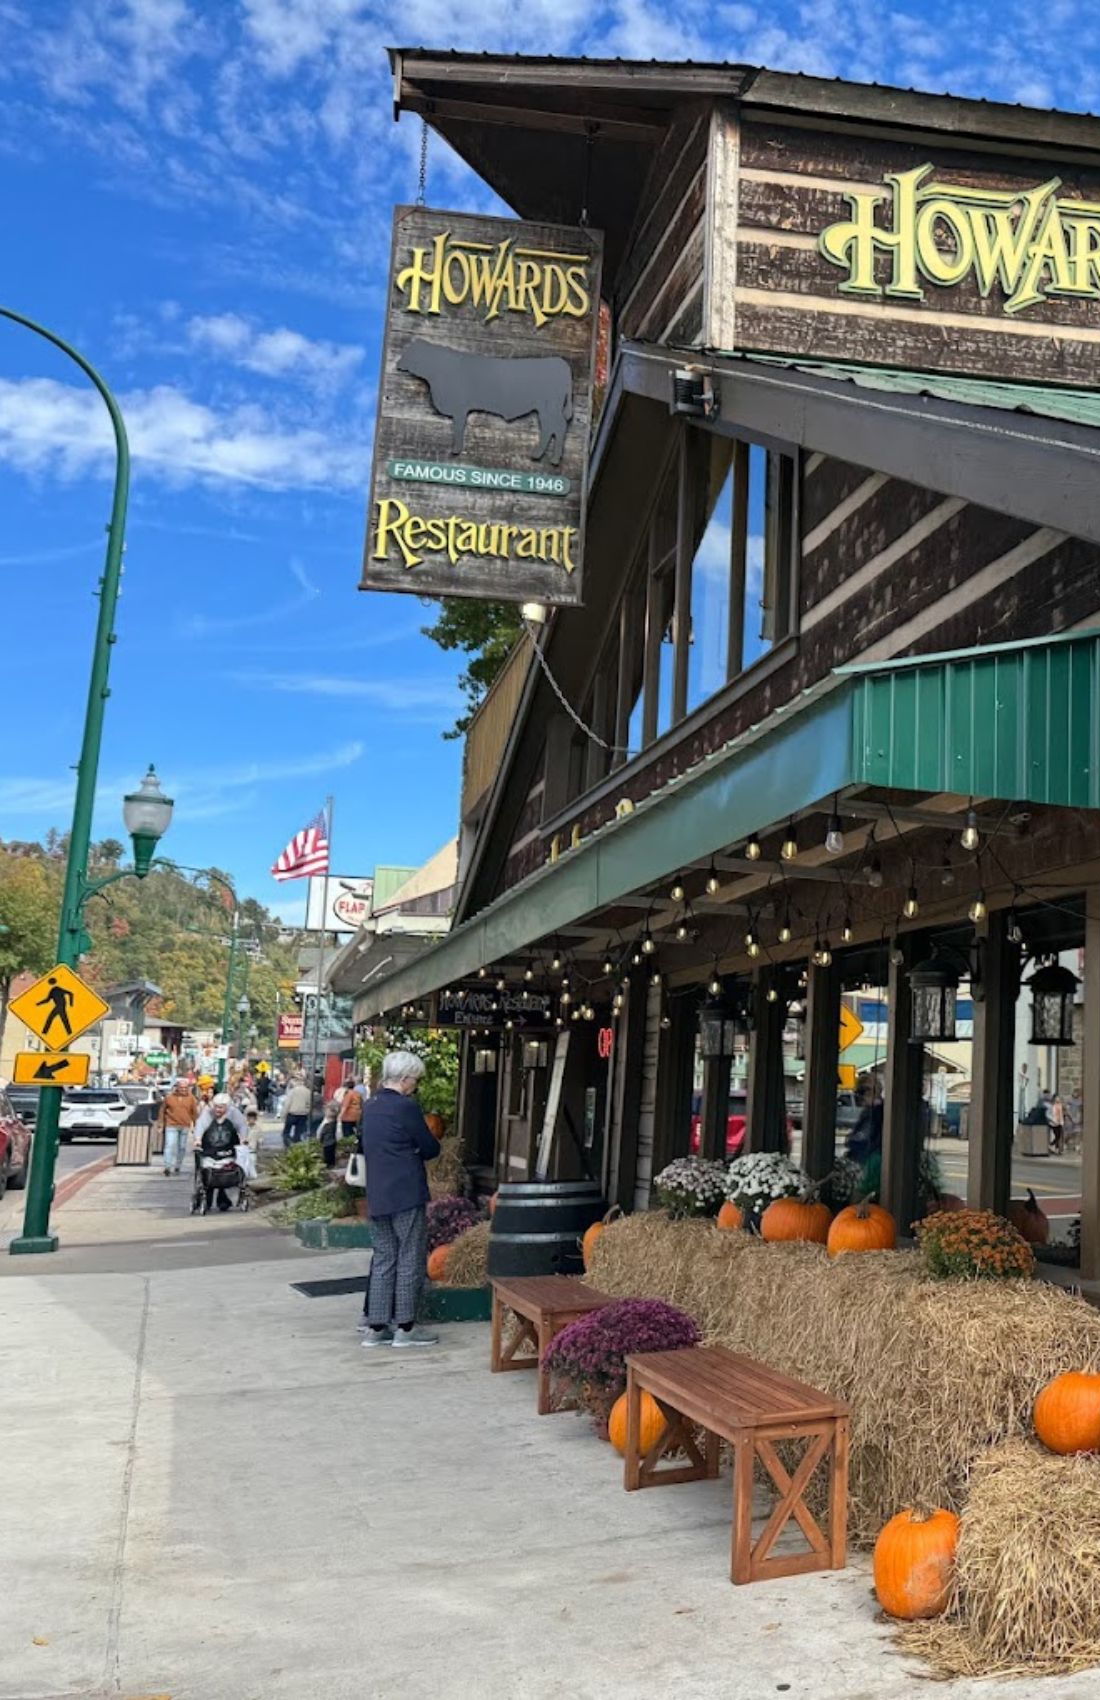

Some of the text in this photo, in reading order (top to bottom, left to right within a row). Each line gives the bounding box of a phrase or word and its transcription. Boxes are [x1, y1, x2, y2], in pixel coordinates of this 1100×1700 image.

[396, 230, 590, 327] HOWARDS
[394, 462, 565, 492] FAMOUS SINCE 1946
[371, 499, 578, 575] Restaurant
[598, 1027, 614, 1058] OP
